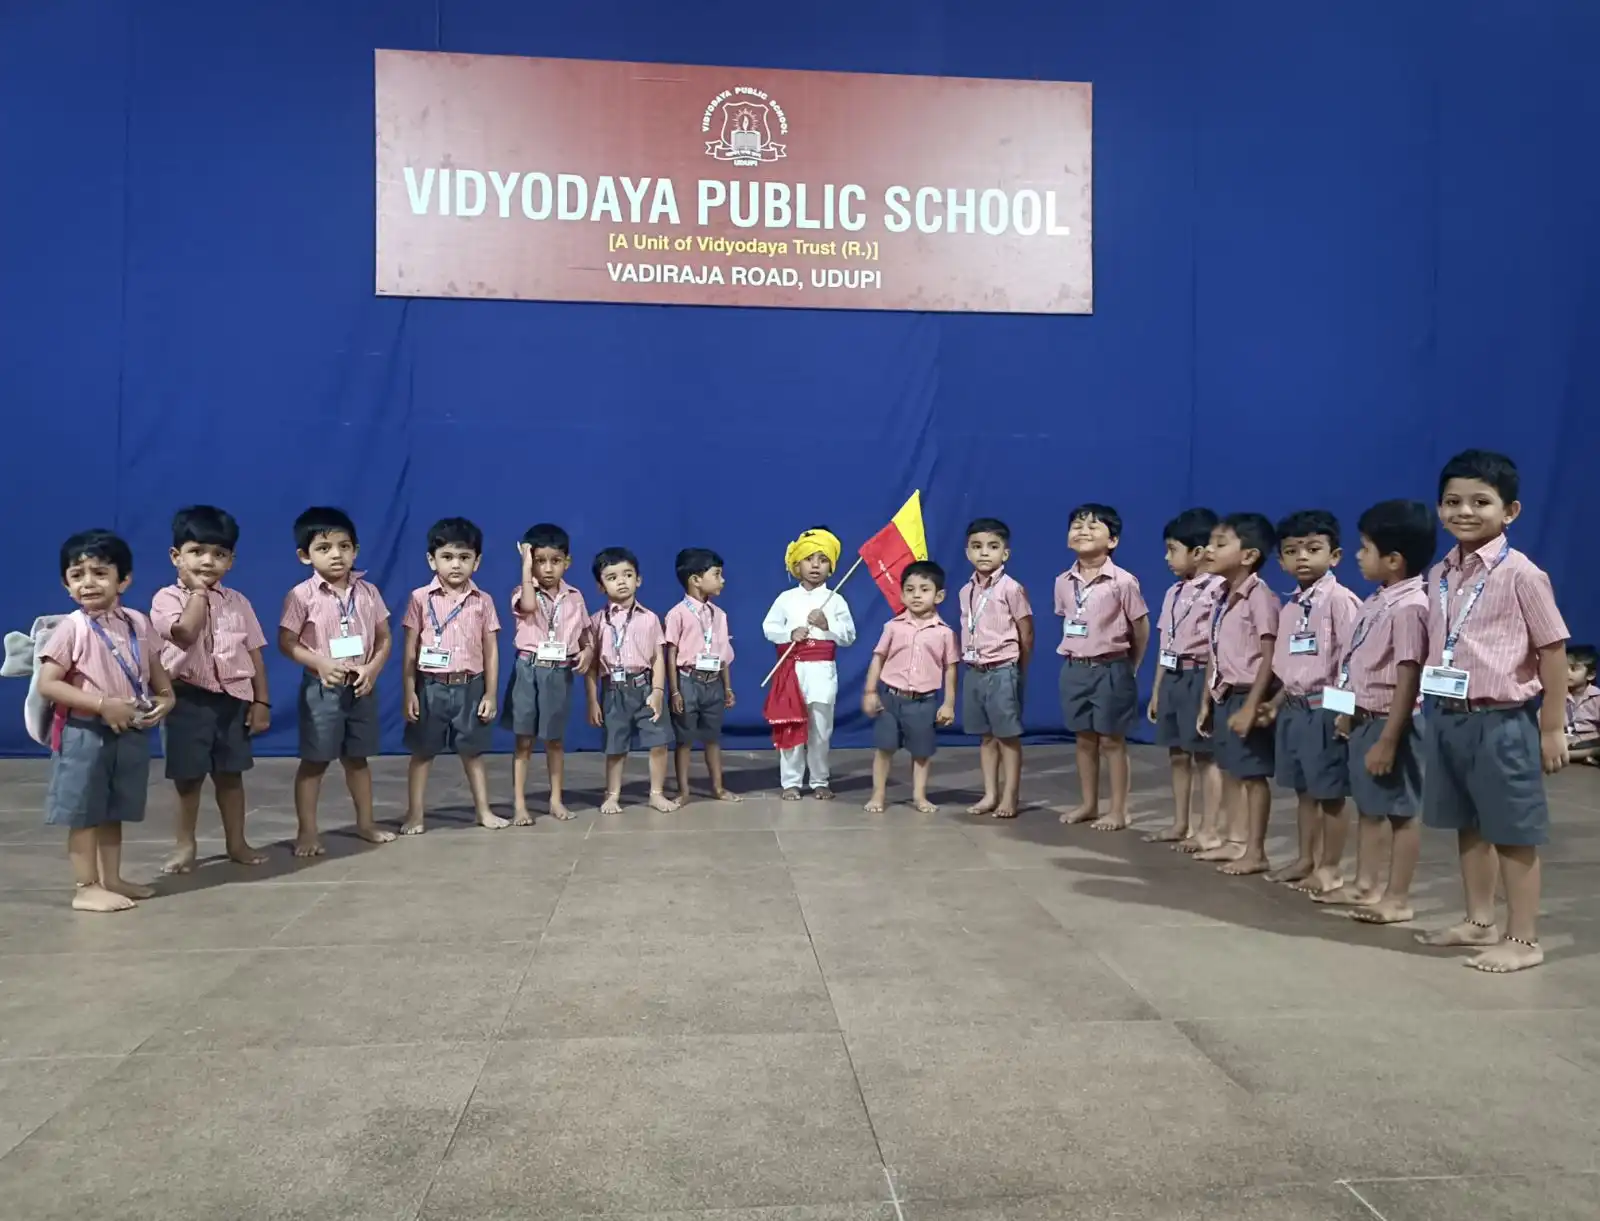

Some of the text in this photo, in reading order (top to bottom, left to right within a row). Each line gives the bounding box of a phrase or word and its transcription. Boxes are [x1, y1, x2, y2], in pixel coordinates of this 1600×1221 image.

[702, 86, 788, 135] VIDYODAYA PUBLIC SCHOOL
[404, 166, 1070, 236] VIDYODAYA PUBLIC SCHOOL
[609, 233, 879, 260] [A Unit of Vidyodaya Trust (R.)]
[606, 262, 881, 290] VADIRAJA ROAD, UDUPI
